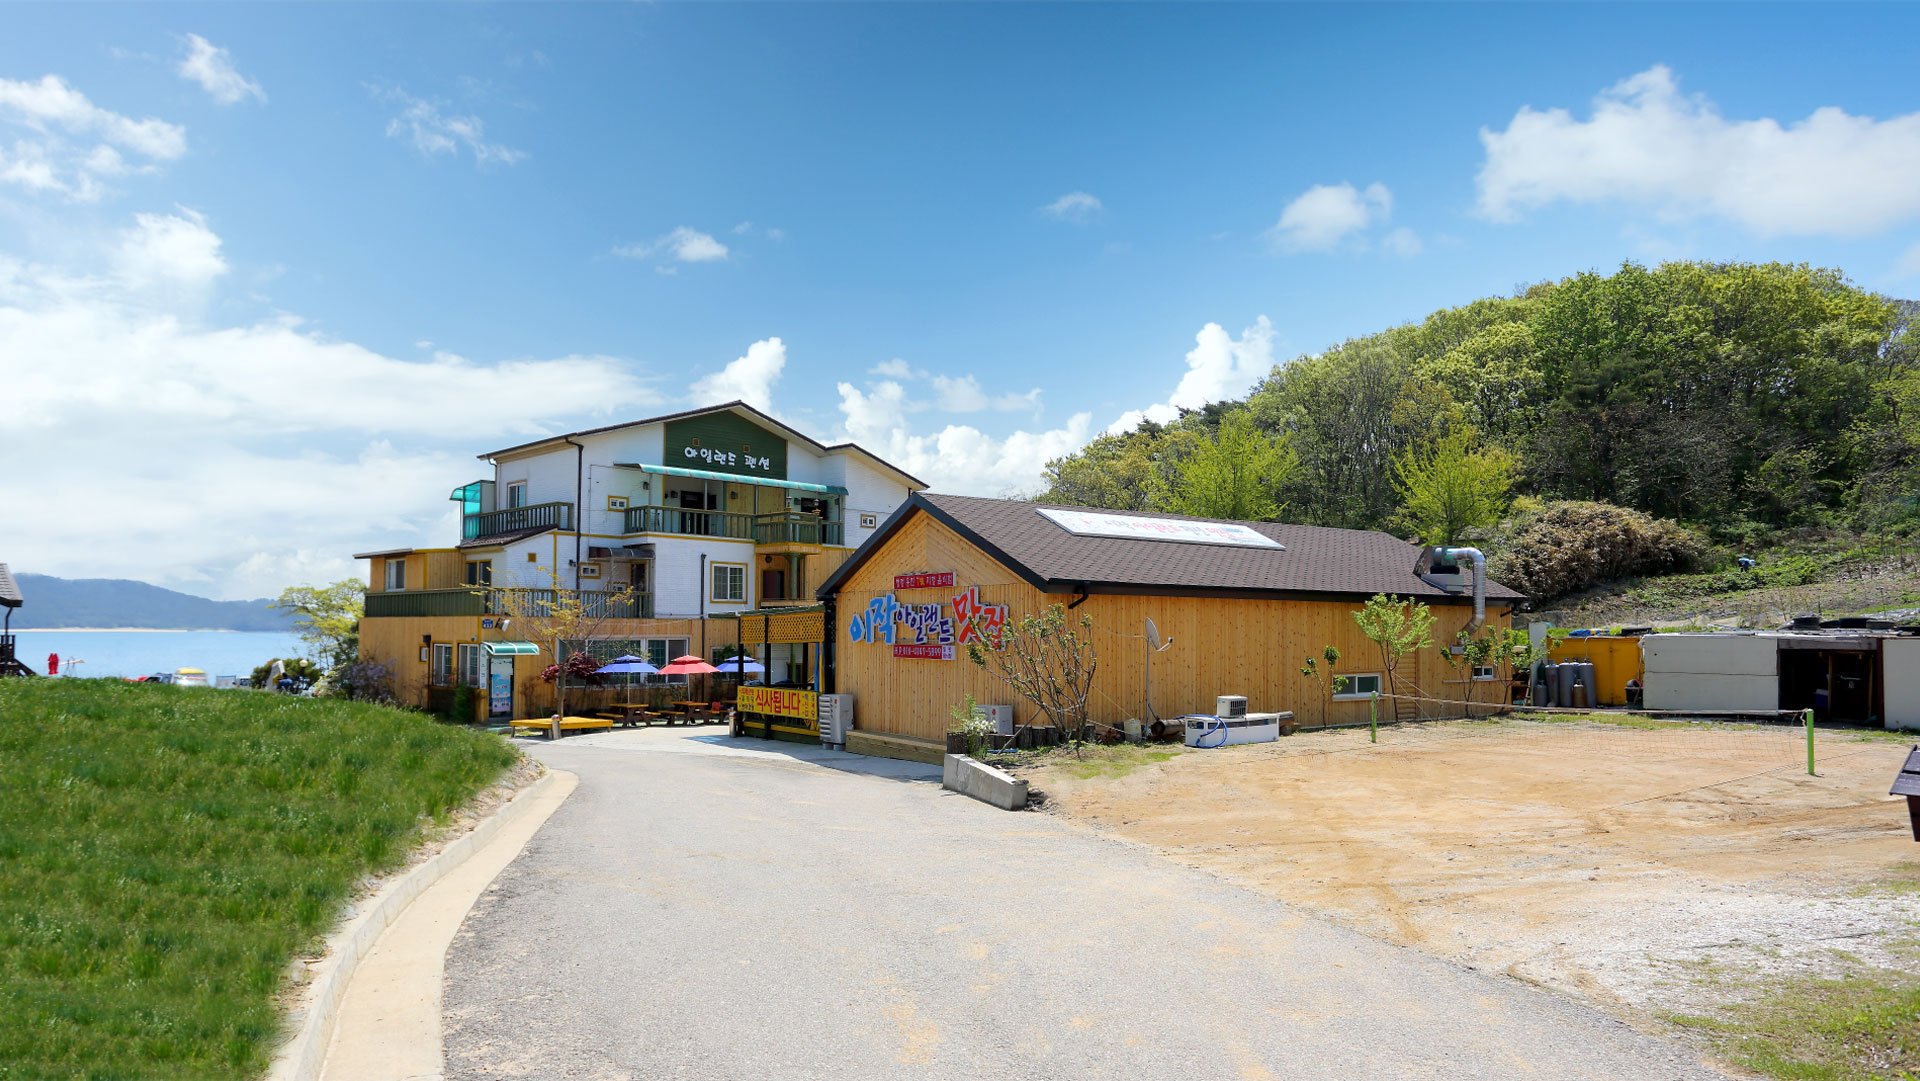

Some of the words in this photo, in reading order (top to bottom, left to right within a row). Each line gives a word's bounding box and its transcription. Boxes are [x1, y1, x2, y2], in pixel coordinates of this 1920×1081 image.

[684, 446, 736, 466] 아일랜드
[744, 454, 770, 471] 펜션
[850, 594, 897, 644] 이작
[897, 604, 951, 643] 아일랜드
[952, 586, 1006, 649] 맛집
[755, 689, 801, 716] 식사됩니다
